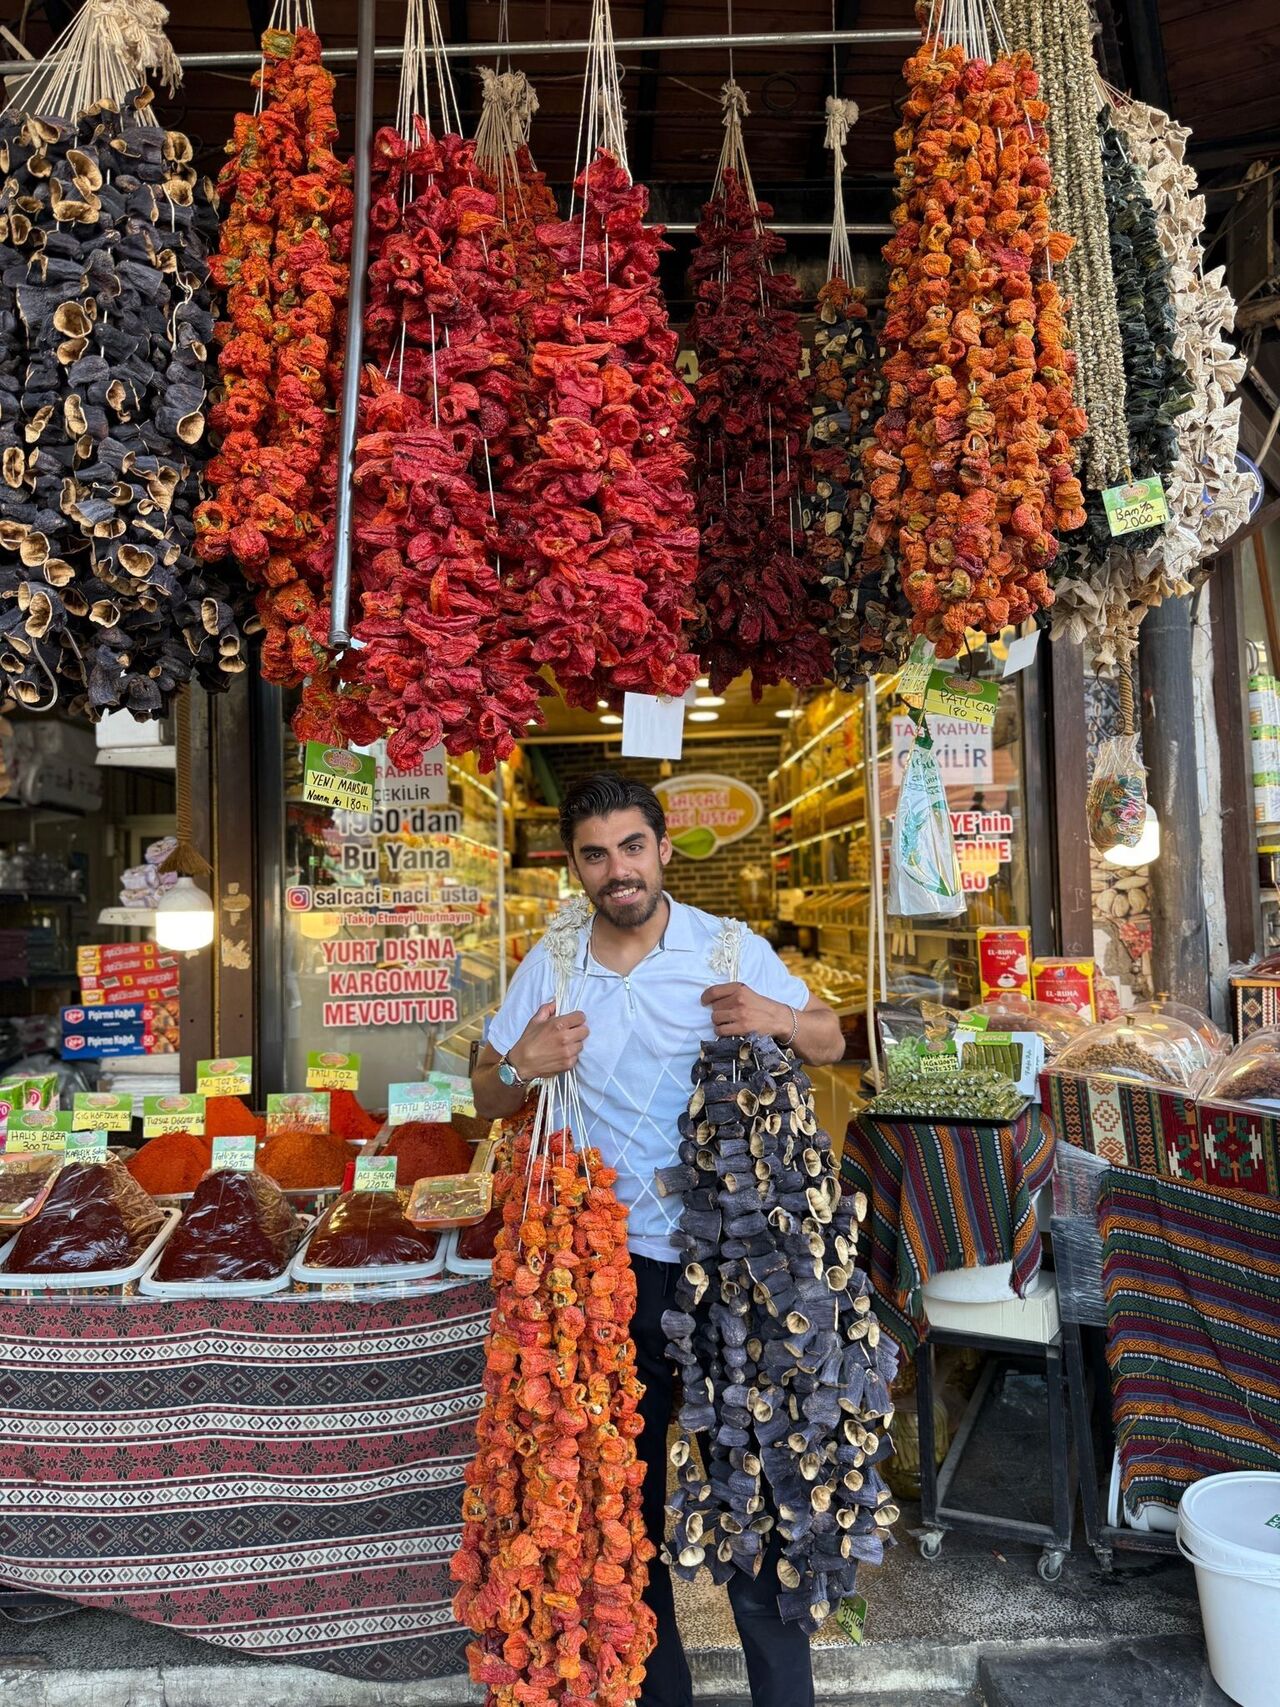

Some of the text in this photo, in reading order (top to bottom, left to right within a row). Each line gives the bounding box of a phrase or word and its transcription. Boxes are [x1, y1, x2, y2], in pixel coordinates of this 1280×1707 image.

[937, 723, 988, 736] KAHVE
[339, 809, 458, 835] 1960'dan
[344, 846, 450, 870] Bu Yana
[316, 887, 478, 906] salcaci_naci_usta
[347, 913, 374, 926] Takip
[378, 913, 413, 926] Etmeyi
[416, 912, 471, 925] Unutmayın
[323, 939, 455, 966] YURT DIŞINA
[330, 970, 448, 994] KARGOMUZ
[324, 999, 456, 1025] MEVCUTTUR
[332, 1070, 352, 1079] TOZ
[42, 1143, 53, 1151] TL
